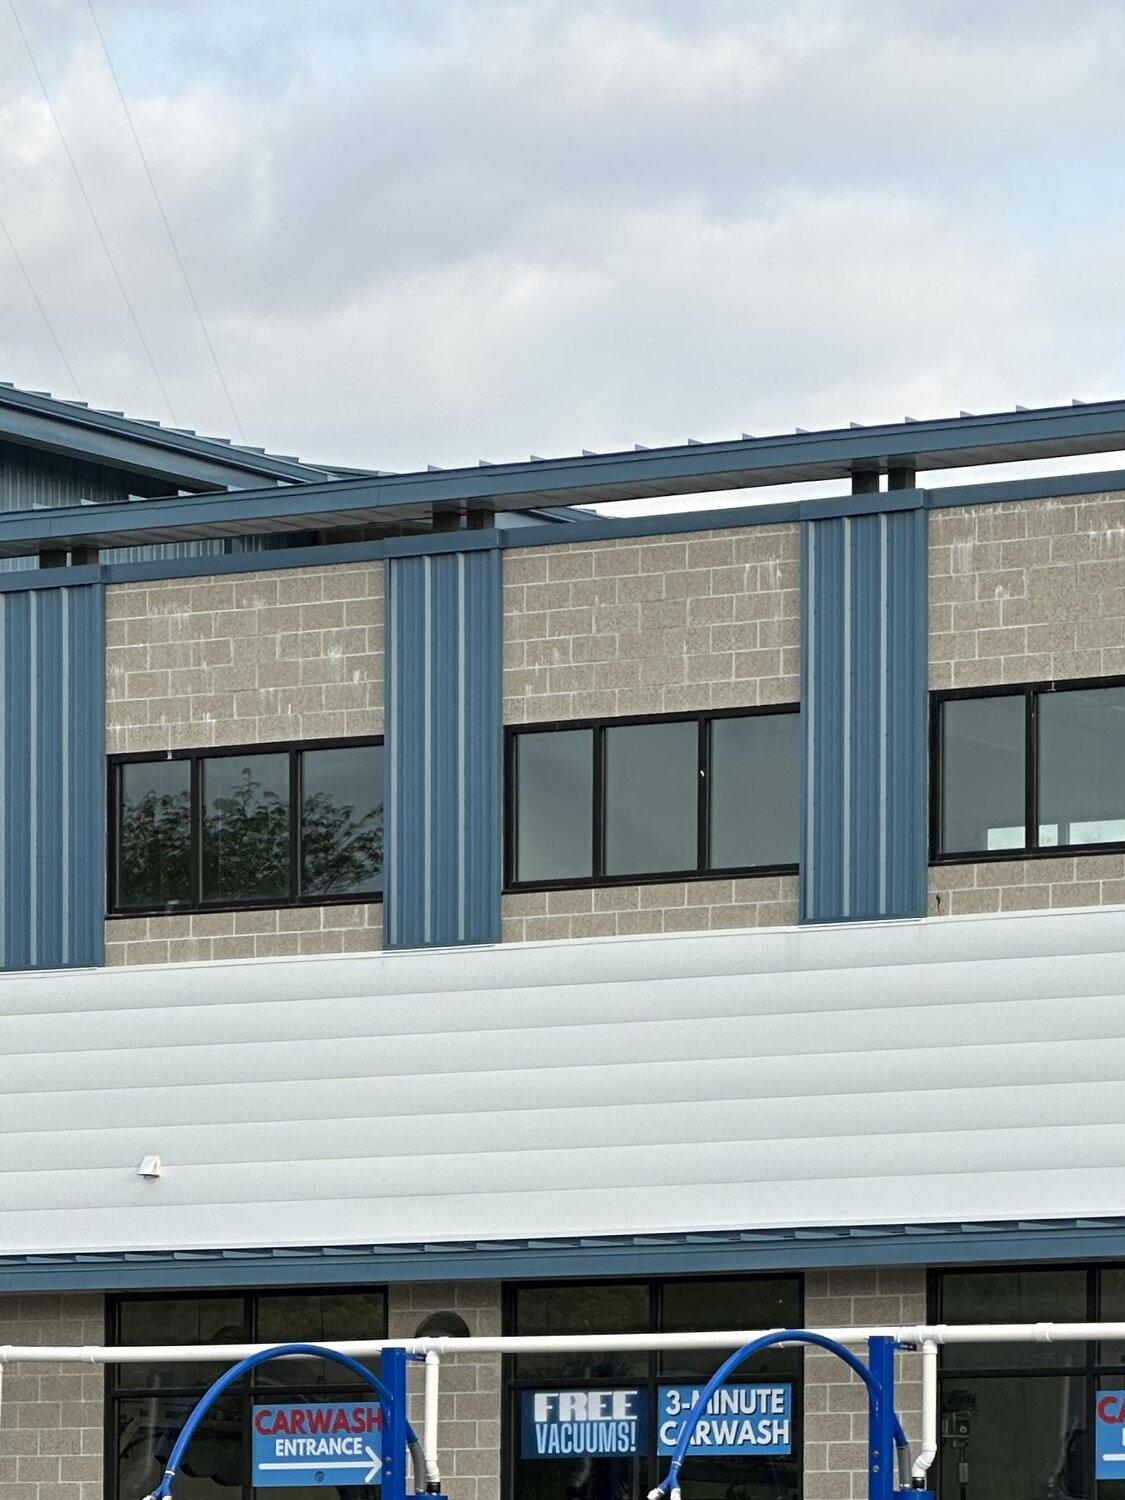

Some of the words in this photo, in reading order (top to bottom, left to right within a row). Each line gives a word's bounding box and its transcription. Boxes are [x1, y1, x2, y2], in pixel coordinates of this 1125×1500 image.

[255, 1407, 383, 1435] CARWASH
[534, 1390, 637, 1422] FREE
[275, 1438, 362, 1456] ENTRANCE
[535, 1422, 636, 1454] VACUUMS!
